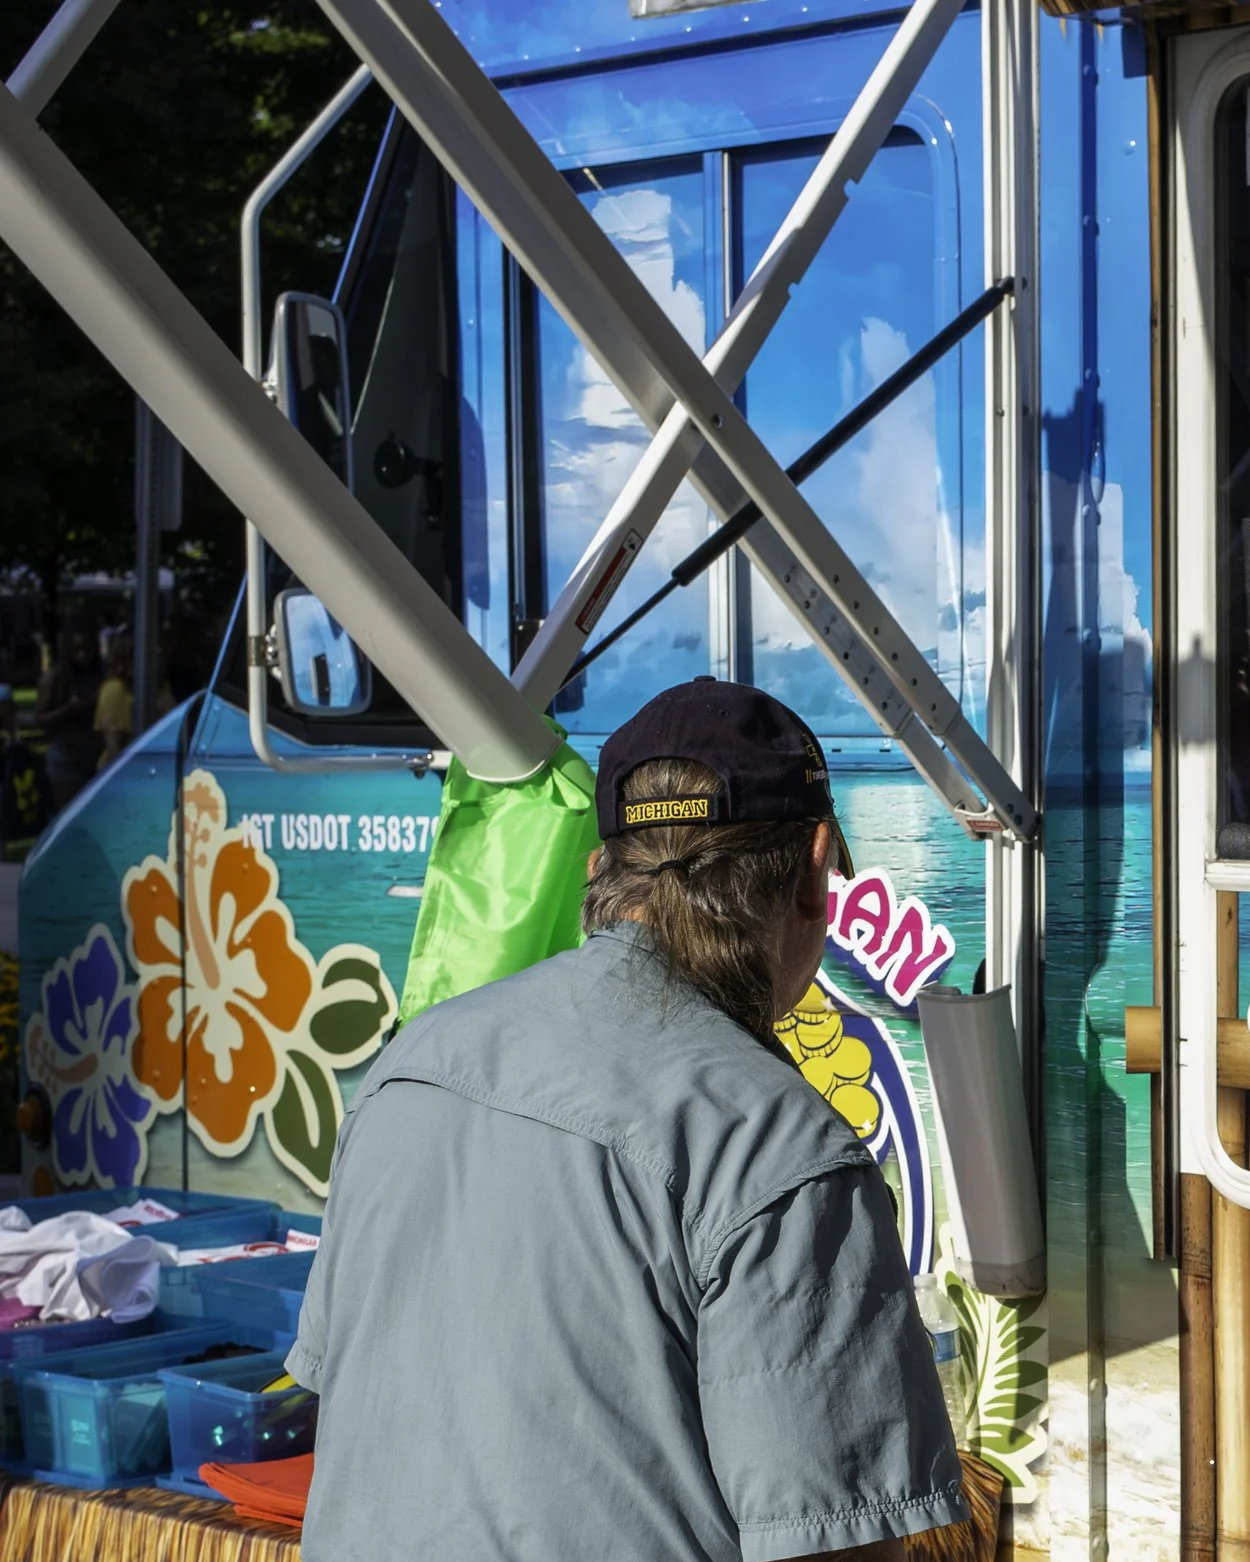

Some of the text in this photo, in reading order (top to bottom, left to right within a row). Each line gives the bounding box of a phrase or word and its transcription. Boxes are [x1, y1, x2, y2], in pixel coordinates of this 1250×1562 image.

[625, 799, 708, 824] MICHIGAN
[242, 813, 275, 850] IGT
[280, 813, 352, 851] USDOT
[828, 867, 955, 1007] AN
